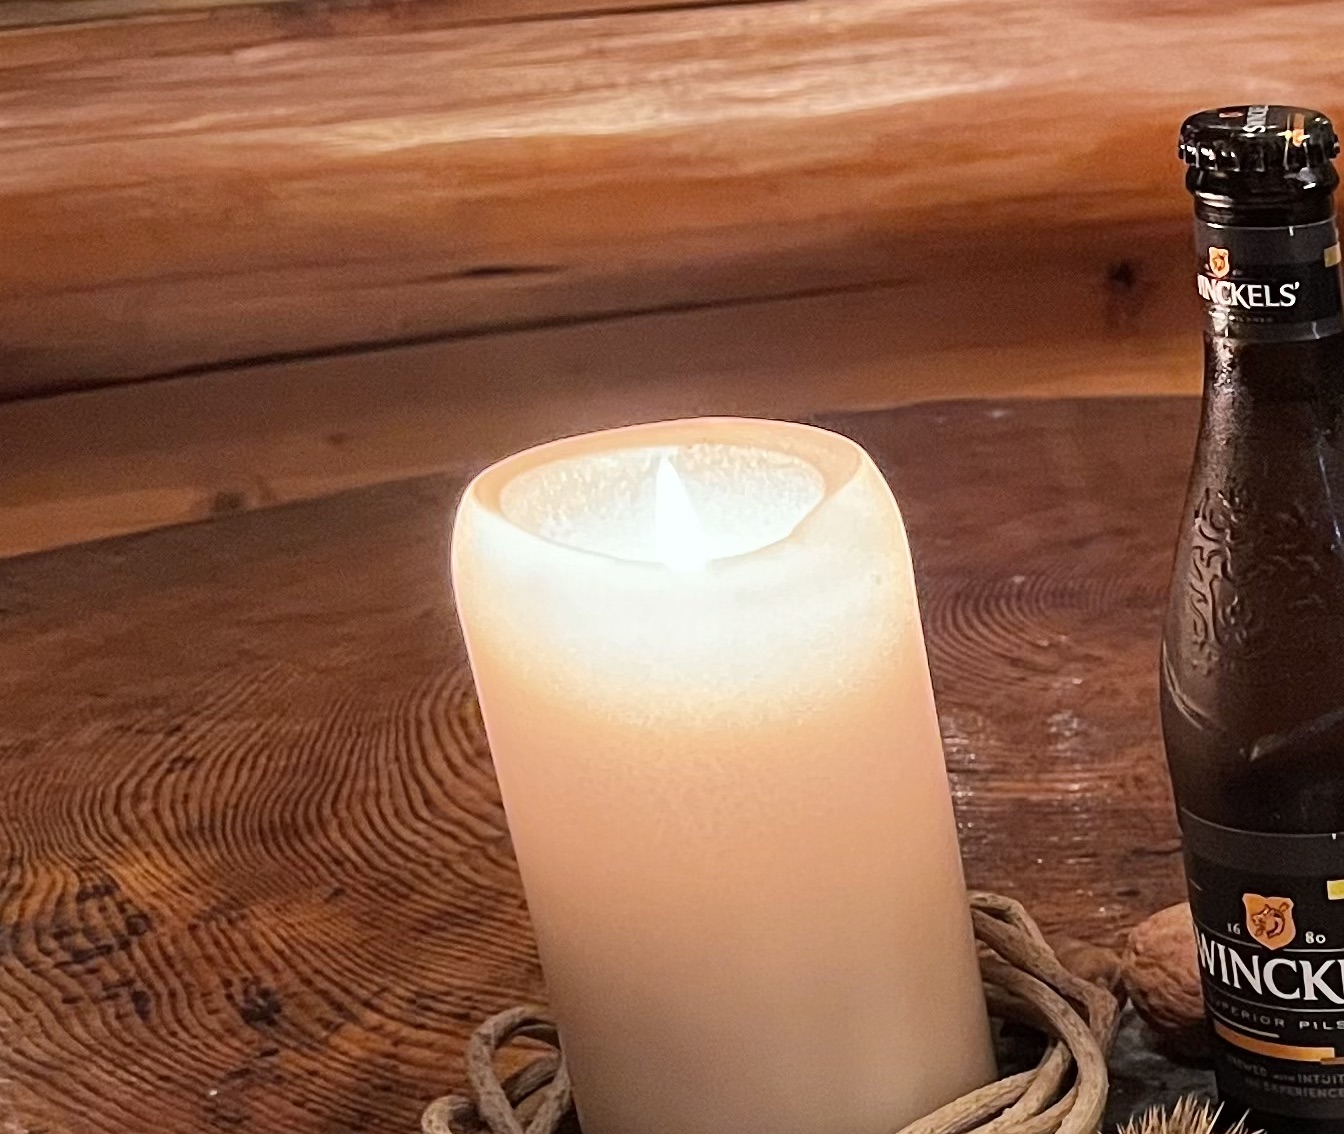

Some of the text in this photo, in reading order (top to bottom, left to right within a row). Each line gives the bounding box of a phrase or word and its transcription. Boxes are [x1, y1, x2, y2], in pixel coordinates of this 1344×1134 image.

[1197, 273, 1300, 310] INCKELS'
[1227, 922, 1241, 935] 16
[1305, 931, 1327, 944] 80
